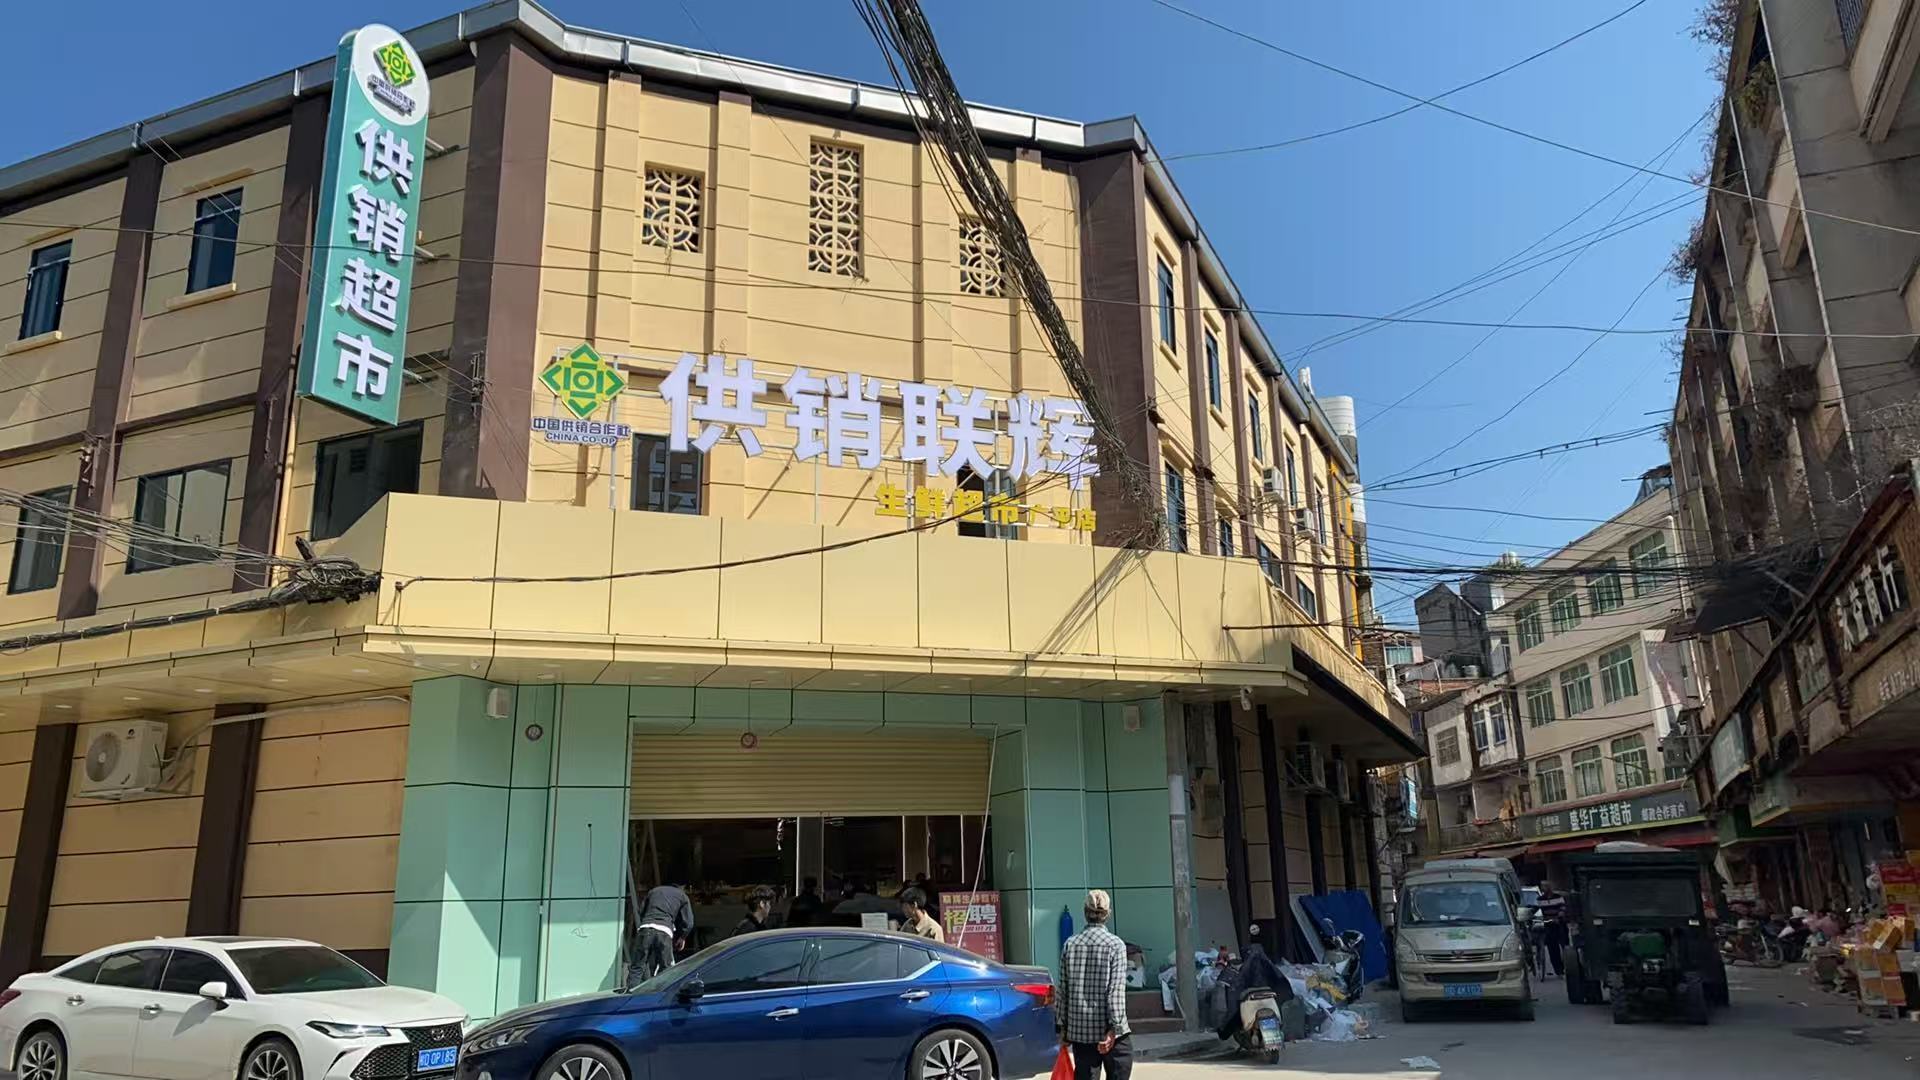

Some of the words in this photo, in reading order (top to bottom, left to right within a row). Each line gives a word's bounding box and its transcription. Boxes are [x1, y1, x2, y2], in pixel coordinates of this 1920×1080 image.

[334, 118, 414, 398] 供销超市
[533, 417, 629, 437] 中国供销合作社
[658, 352, 1102, 489] 供销联辉
[546, 432, 579, 442] CHINA
[582, 436, 616, 445] CO-OP
[944, 904, 997, 934] 招聘
